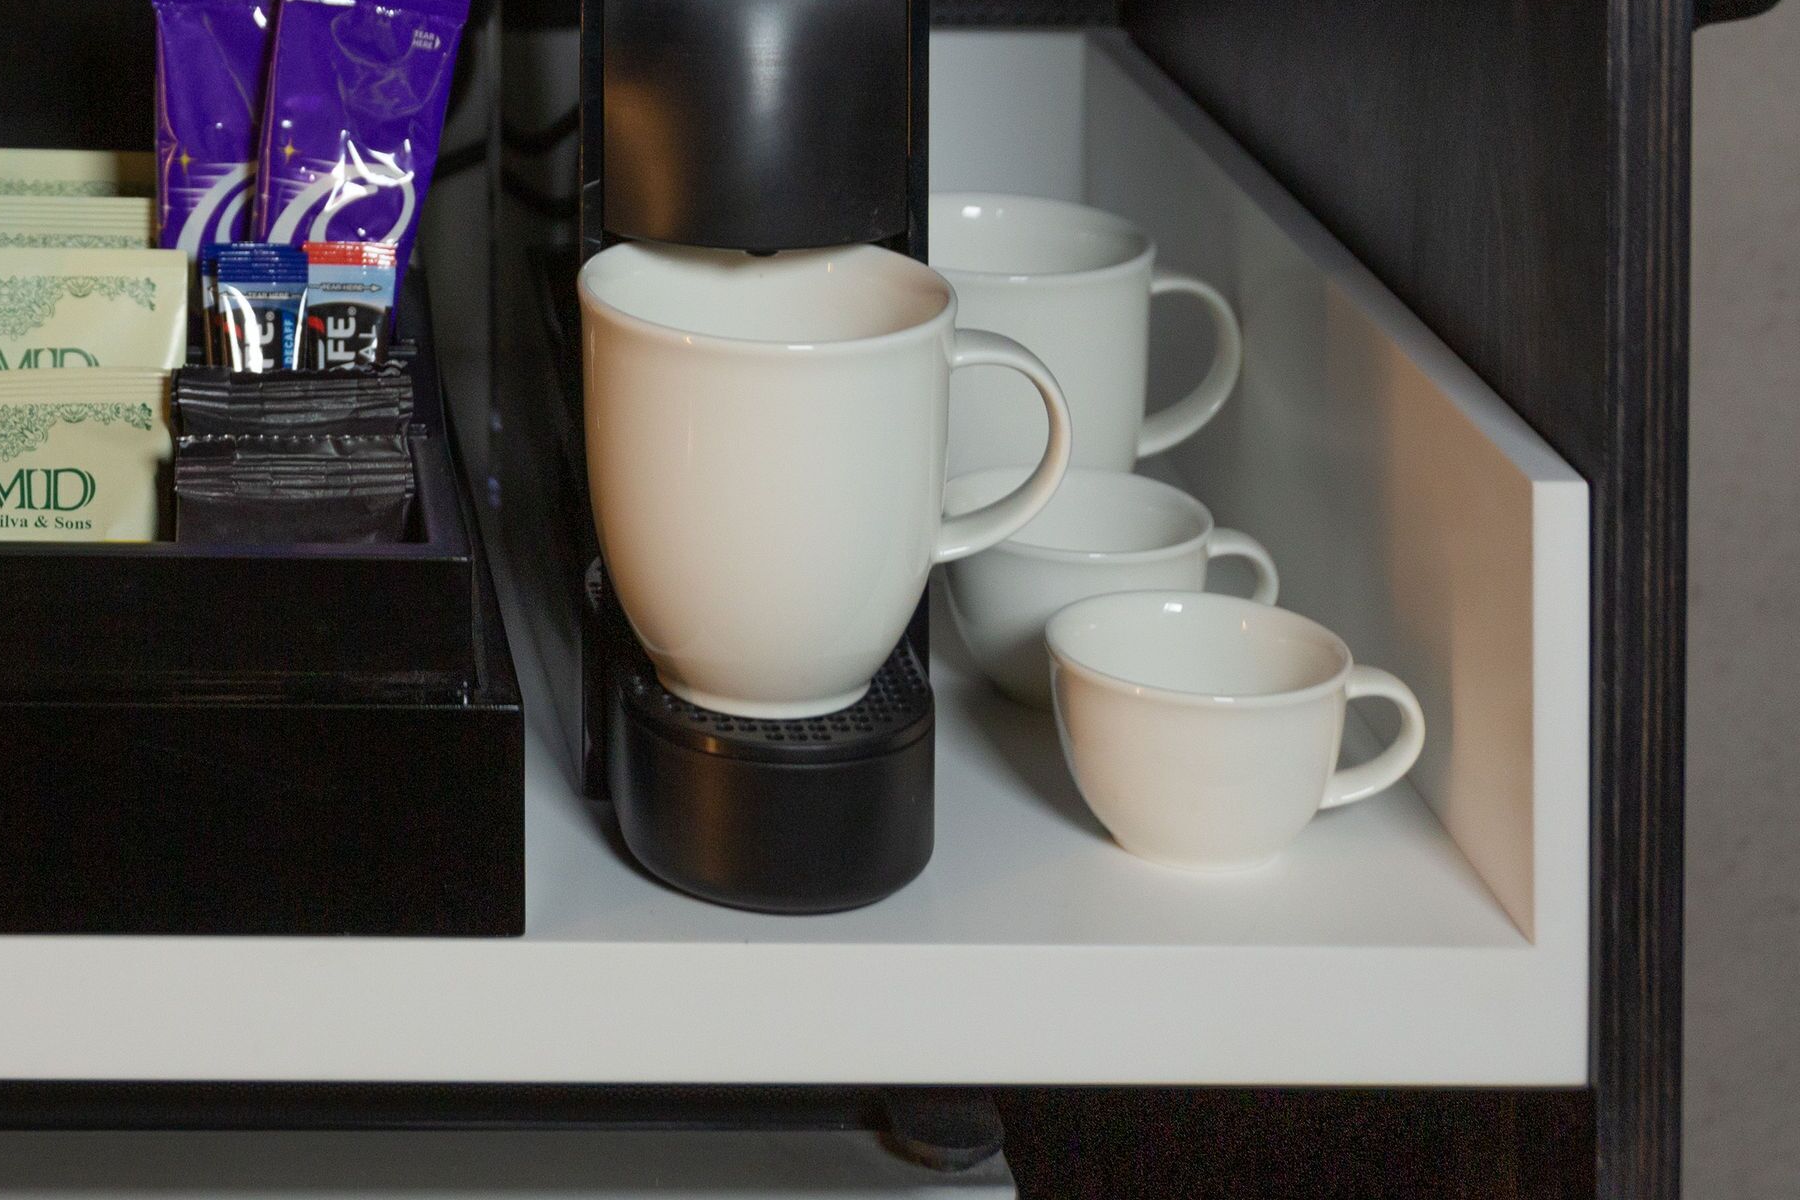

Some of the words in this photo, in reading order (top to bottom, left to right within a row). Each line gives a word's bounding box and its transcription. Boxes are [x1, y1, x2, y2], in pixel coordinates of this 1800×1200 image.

[283, 319, 295, 365] DECAFF
[33, 515, 49, 528] &
[54, 516, 93, 530] Sons
